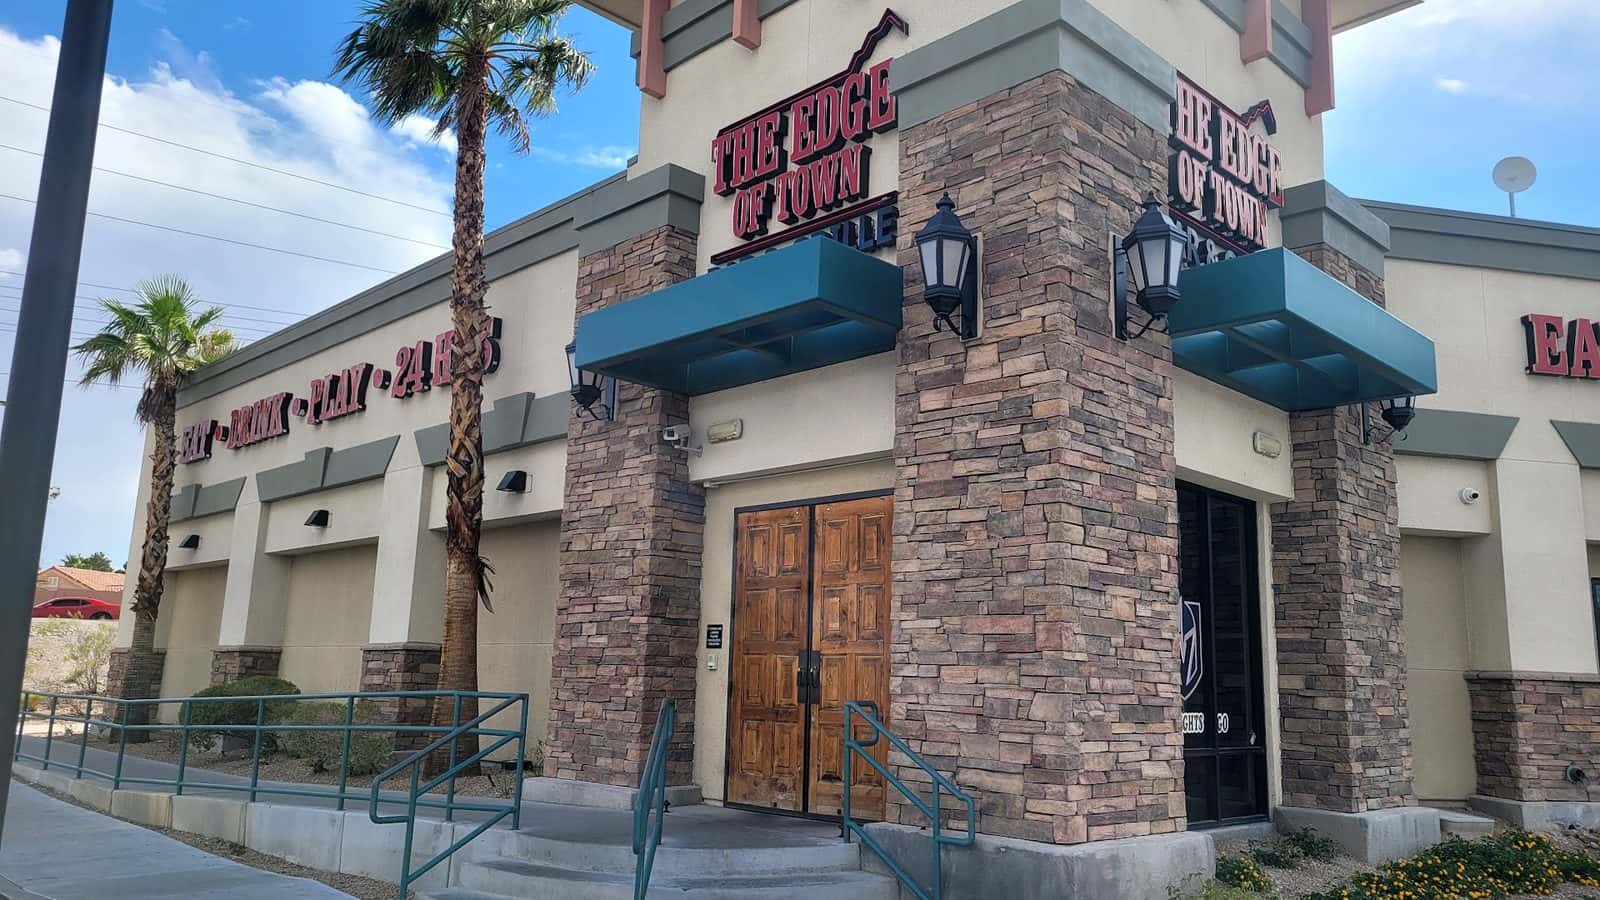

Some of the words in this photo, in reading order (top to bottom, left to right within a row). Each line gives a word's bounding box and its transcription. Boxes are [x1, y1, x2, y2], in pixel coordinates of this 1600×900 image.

[711, 111, 780, 195] THE
[790, 57, 897, 165] EDGE
[1177, 76, 1213, 160] HE
[1218, 108, 1284, 207] EDGE
[732, 183, 770, 239] OF
[774, 143, 866, 224] TOWN
[1176, 150, 1207, 222] OF
[1211, 171, 1270, 248] TOWN
[1520, 313, 1600, 379] EA
[176, 420, 210, 464] EAT
[226, 392, 286, 449] DRINK
[306, 363, 368, 425] PLAY
[391, 340, 426, 399] 24
[1182, 711, 1205, 733] GHTS
